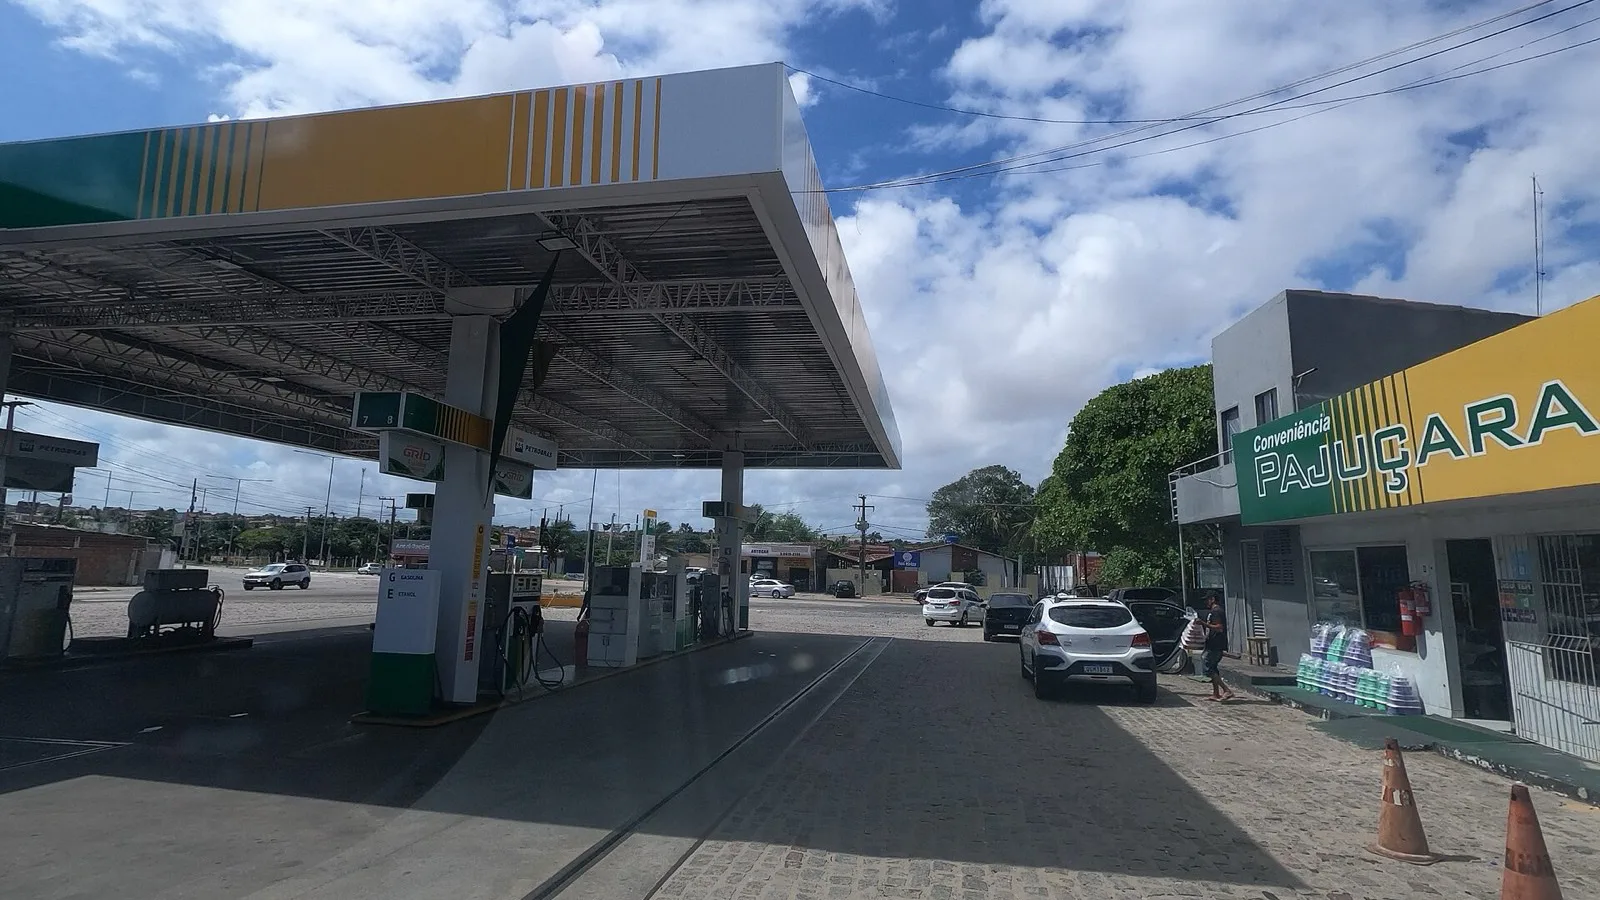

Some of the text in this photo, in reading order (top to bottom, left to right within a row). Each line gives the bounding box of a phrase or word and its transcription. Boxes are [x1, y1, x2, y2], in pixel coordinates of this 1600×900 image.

[362, 415, 393, 425] 7 8
[1253, 413, 1331, 453] Conveniência
[1253, 379, 1600, 497] PAJUÇARA
[525, 444, 553, 458] PETROBRAS
[389, 572, 396, 582] G
[387, 588, 394, 599] E
